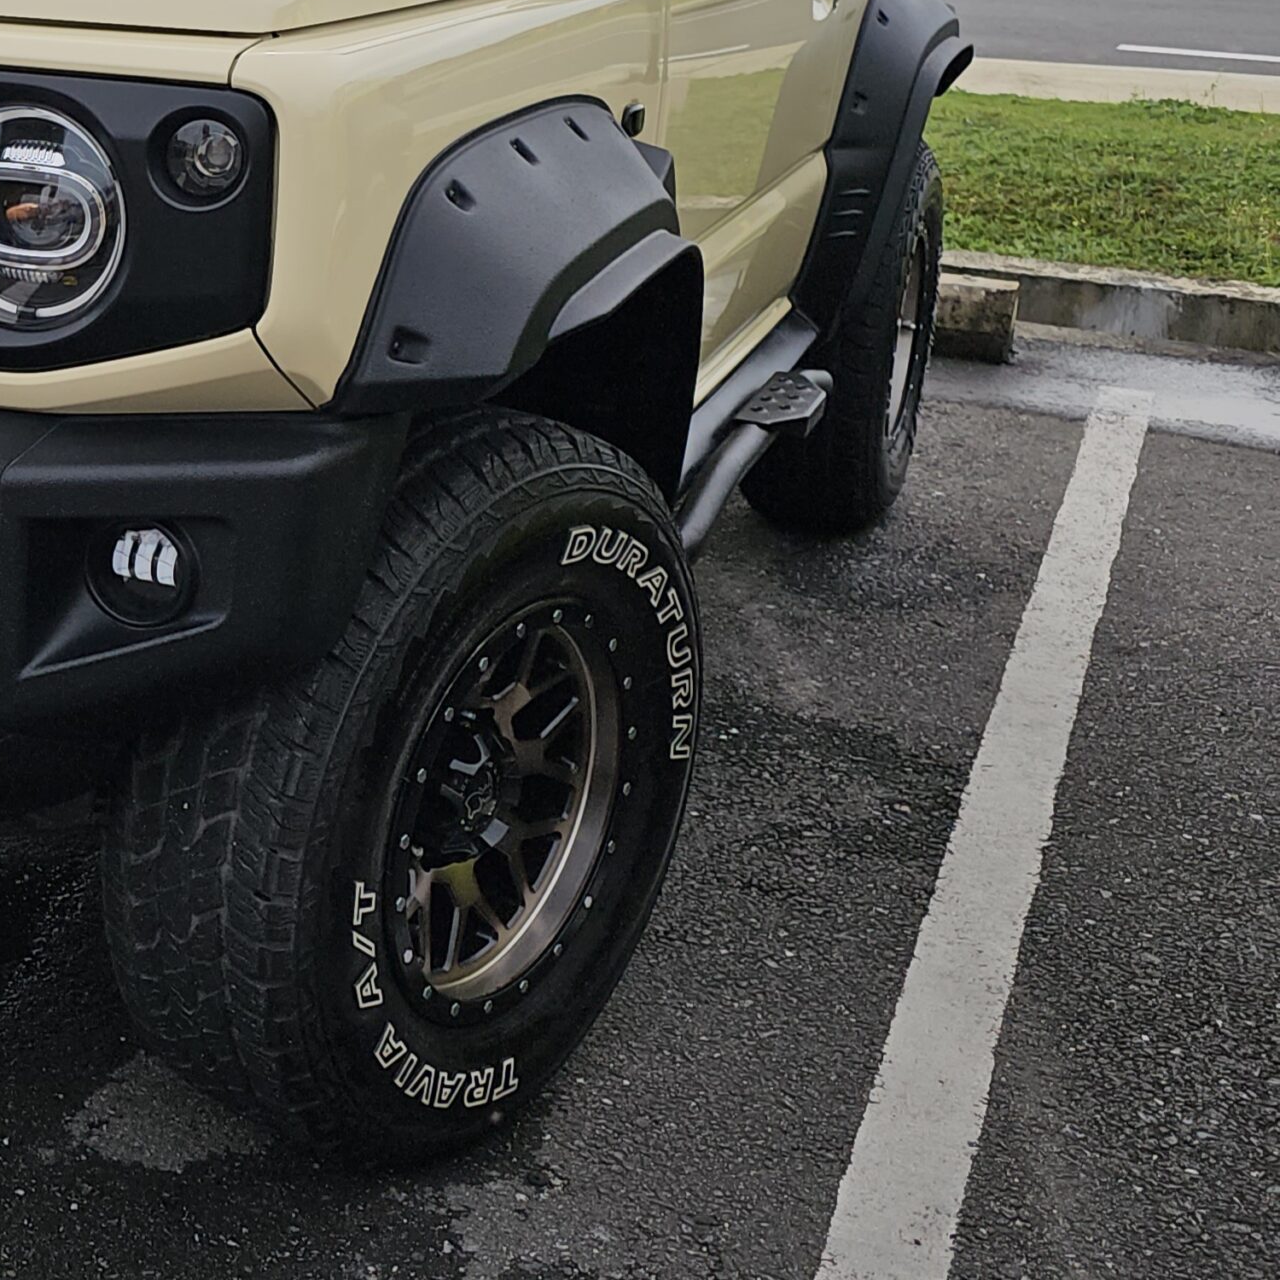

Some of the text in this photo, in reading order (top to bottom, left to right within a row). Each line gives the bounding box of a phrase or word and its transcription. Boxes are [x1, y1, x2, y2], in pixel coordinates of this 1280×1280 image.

[561, 524, 695, 760] DURATURN
[352, 881, 520, 1109] TRAVIA A/T
